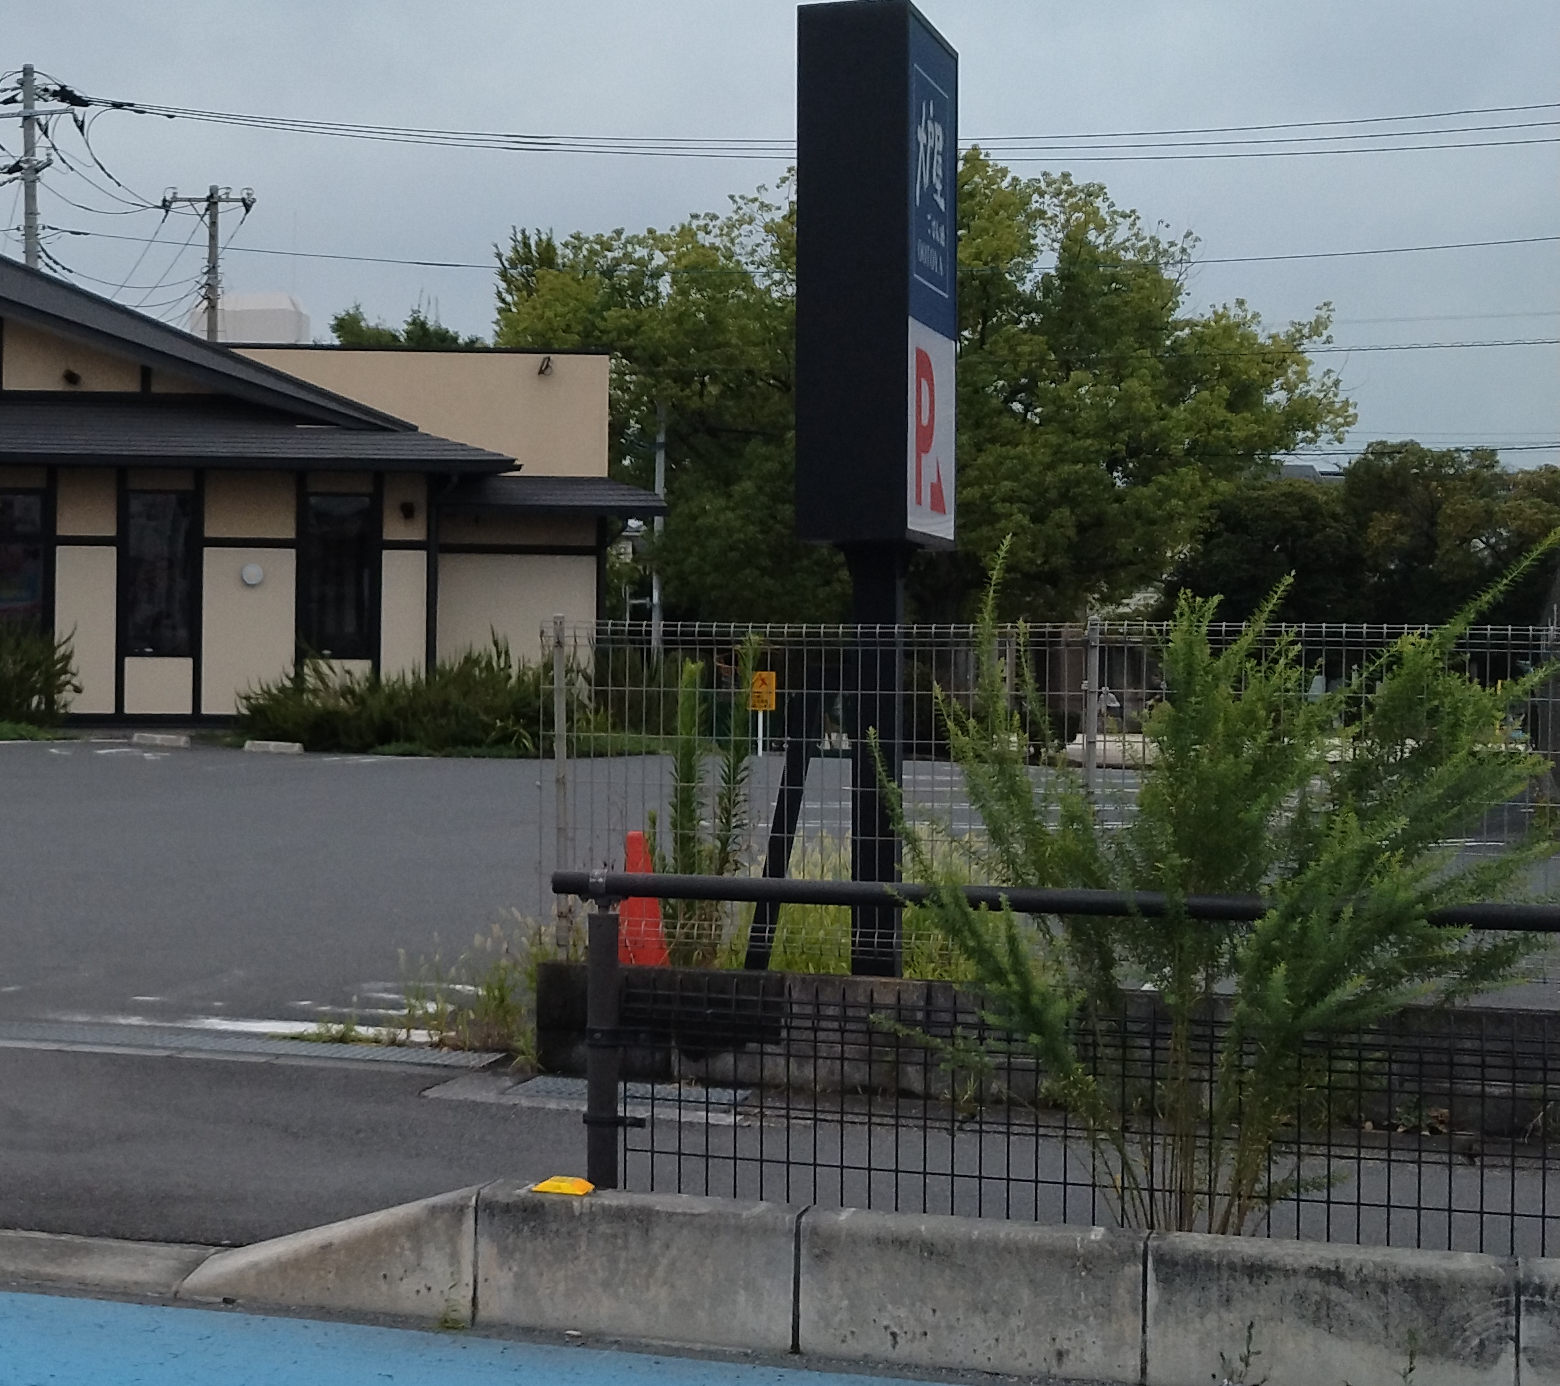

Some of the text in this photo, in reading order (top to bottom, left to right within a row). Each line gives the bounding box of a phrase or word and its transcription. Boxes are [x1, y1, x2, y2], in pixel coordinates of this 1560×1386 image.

[916, 100, 945, 212] 大戸屋
[915, 346, 935, 506] P
